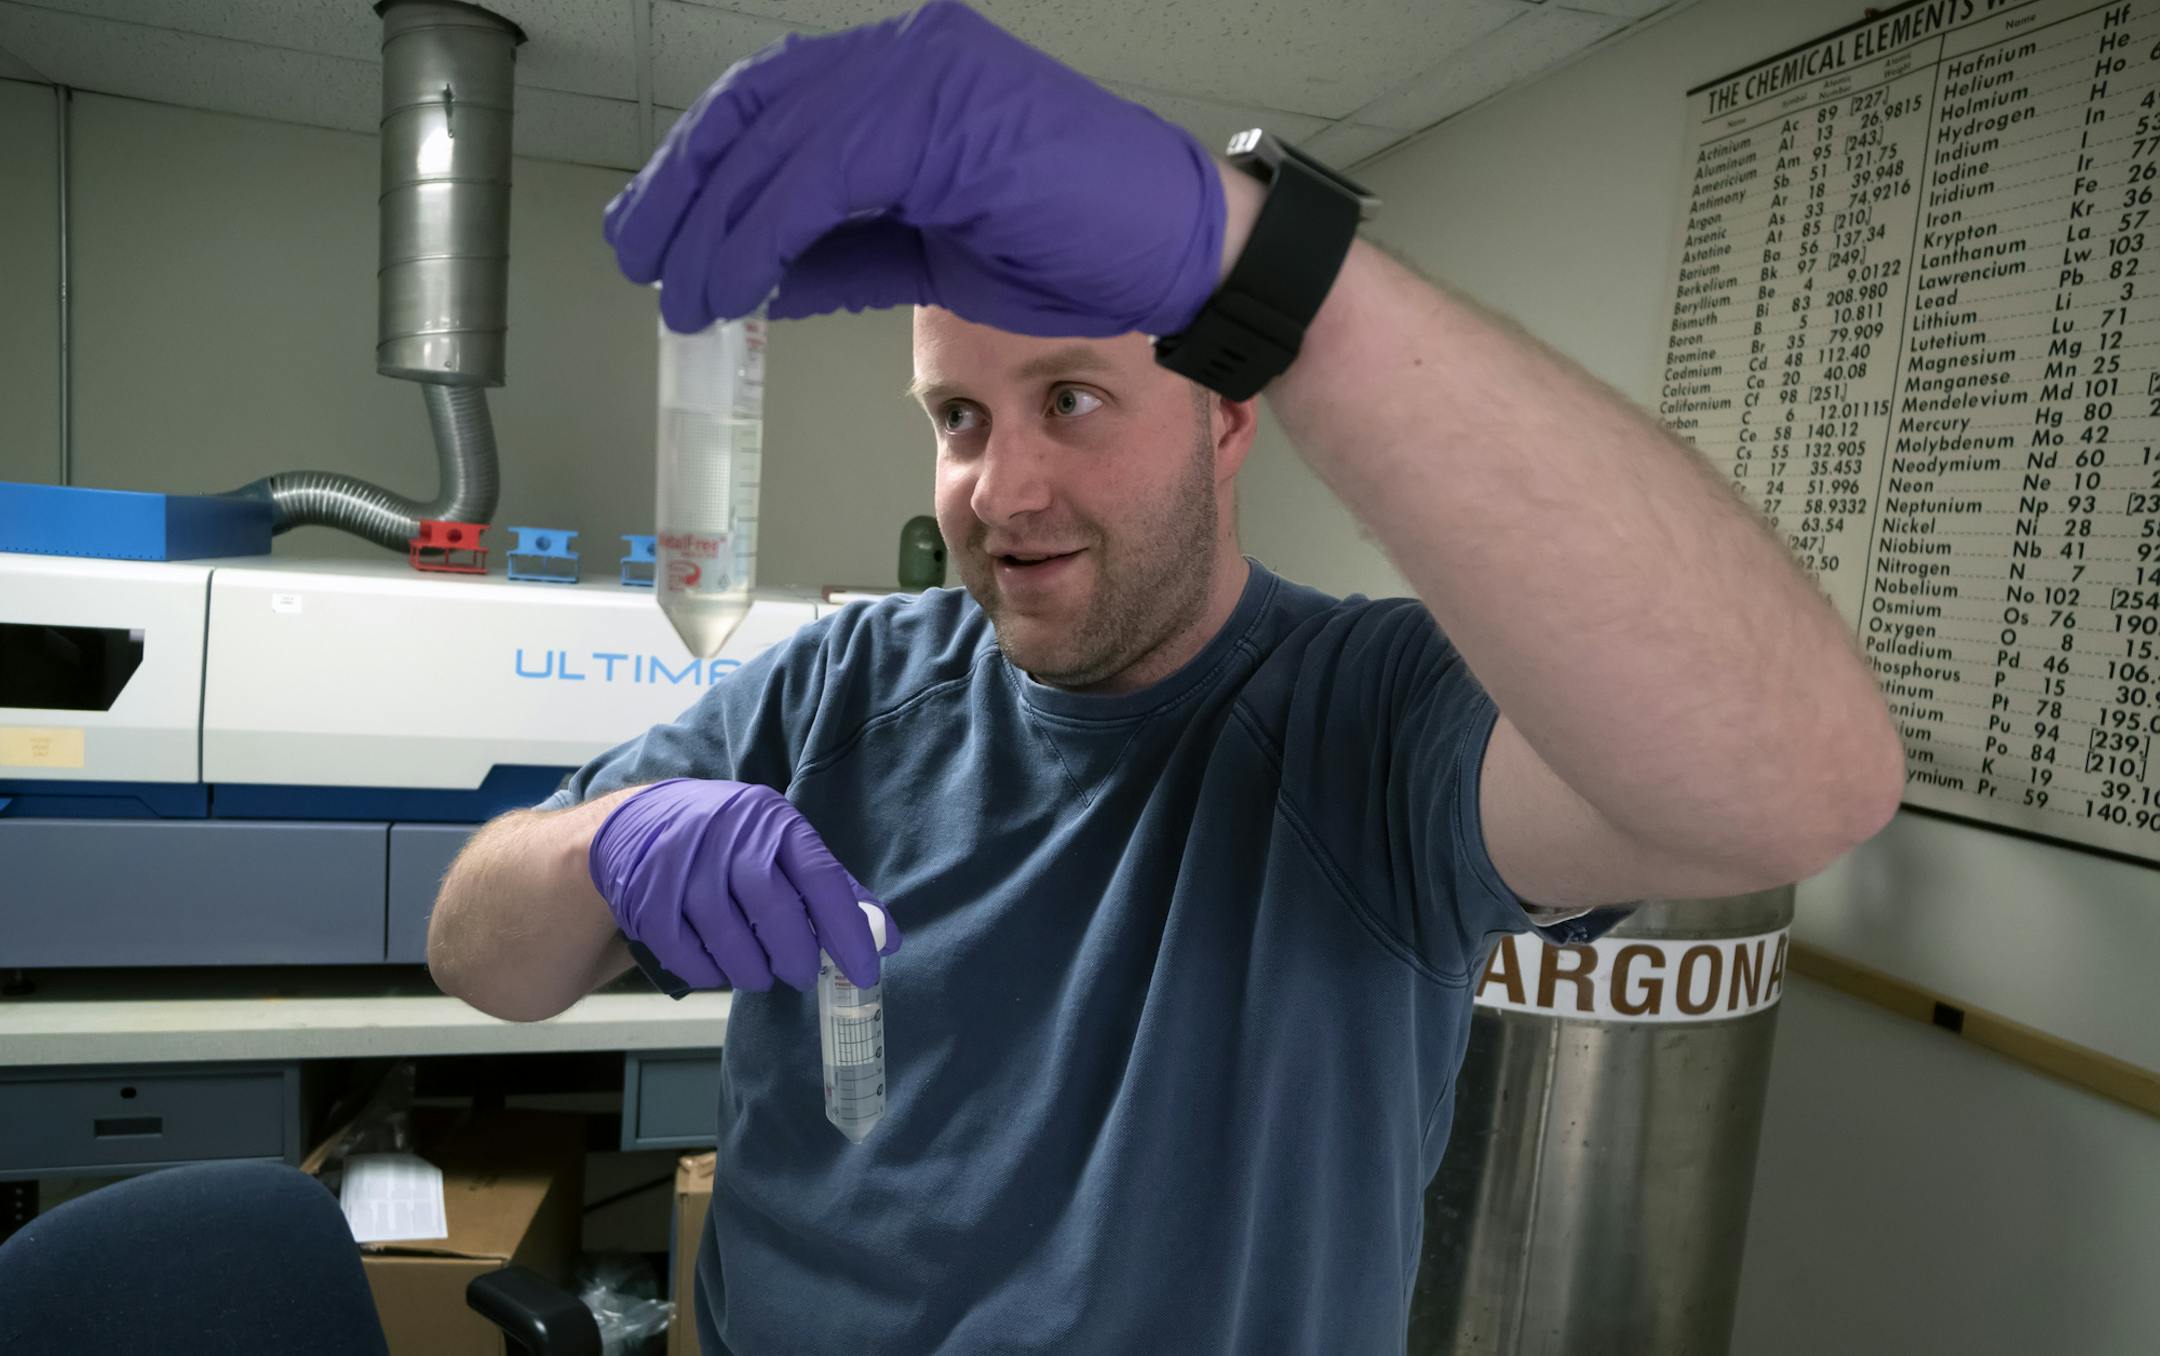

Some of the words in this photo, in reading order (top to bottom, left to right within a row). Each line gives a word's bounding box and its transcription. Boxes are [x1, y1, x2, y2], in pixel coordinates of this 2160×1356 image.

[2006, 14, 2036, 30] Name
[1947, 42, 2036, 80] Hafnium
[2103, 3, 2131, 29] Hf
[1708, 82, 1740, 114] THE
[1745, 40, 1846, 100] CHEMICAL
[1853, 0, 1973, 62] ELEMENTS
[1944, 69, 2014, 101] Helium
[2099, 32, 2130, 54] He
[1941, 86, 2028, 123] Holmium
[2095, 56, 2126, 78] Ho
[1816, 125, 1833, 142] 13
[1860, 94, 1922, 130] 26.9815
[1817, 105, 1838, 123] 89
[1938, 105, 2036, 144] Hydrogen
[1935, 137, 1999, 166] Indium
[2085, 107, 2105, 125] In
[1809, 164, 1827, 180] 51
[1846, 144, 1898, 172] 121.75
[1812, 146, 1832, 162] 95
[1809, 183, 1824, 199] 18
[1852, 161, 1904, 189] 39.948
[1930, 180, 1995, 207] Iridium
[2076, 155, 2094, 172] Ir
[1932, 161, 1990, 186] Iodine
[1804, 202, 1824, 219] 33
[1849, 179, 1910, 208] 74.9216
[1926, 210, 1962, 229] Iron
[2074, 178, 2098, 196] Fe
[2128, 162, 2158, 184] 26
[1802, 221, 1821, 238] 85
[1923, 223, 1998, 250] Krypton
[2070, 201, 2095, 219] Kr
[2123, 186, 2153, 208] 36
[1799, 240, 1818, 256] 56
[1835, 224, 1885, 250] 137.34
[1921, 239, 2026, 270] Lanthanum
[2066, 225, 2091, 242] La
[2118, 210, 2149, 232] 57
[1798, 259, 1818, 274] 97
[1848, 259, 1901, 282] 9.0122
[1918, 260, 2026, 291] Lawrencium
[2063, 248, 2092, 266] Lw
[2109, 233, 2145, 257] 103
[1792, 296, 1811, 313] 83
[1826, 282, 1888, 307] 208.980
[1915, 289, 1958, 310] Lead
[2059, 268, 2084, 288] Pb
[2110, 259, 2139, 280] 82
[1669, 334, 1703, 348] Boron
[1834, 302, 1883, 324] 10.811
[1913, 311, 1977, 332] Lithium
[2055, 292, 2072, 311] Li
[1667, 349, 1716, 365] Bromine
[1751, 340, 1765, 354] Br
[1787, 335, 1805, 350] 35
[1828, 322, 1884, 345] 79.909
[1910, 332, 1986, 352] Lutetium
[2052, 317, 2074, 334] Lu
[2100, 307, 2127, 328] 71
[1664, 364, 1722, 382] Cadmium
[1750, 356, 1768, 372] Cd
[1784, 352, 1803, 367] 48
[1819, 343, 1870, 364] 112.40
[1907, 348, 2016, 373] Magnesium
[2048, 339, 2083, 358] Mg
[2100, 332, 2123, 350] 12
[1662, 382, 1711, 398] Calcium
[1747, 375, 1765, 390] Ca
[1782, 370, 1800, 386] 20
[1824, 362, 1867, 381] 40.08
[1905, 370, 2010, 394] Manganese
[2044, 362, 2077, 380] Mn
[2092, 355, 2120, 375] 25
[1660, 397, 1731, 415] Californium
[1780, 389, 1797, 404] 98
[1820, 399, 1889, 419] 12.01115
[1902, 390, 2028, 414] Mendelevium
[2040, 382, 2073, 402] Md
[2084, 378, 2119, 398] 101
[1740, 428, 1757, 442] Ce
[1774, 426, 1792, 441] 58
[1808, 422, 1859, 439] 140.12
[1899, 417, 1970, 434] Mercury
[2035, 407, 2063, 428] Hg
[2084, 403, 2113, 422] 80
[1771, 445, 1789, 459] 55
[1805, 441, 1866, 457] 132.905
[1895, 435, 2014, 456] Molybdenum
[2032, 430, 2064, 447] Mo
[2080, 426, 2109, 445] 42
[1770, 462, 1785, 476] 17
[1810, 460, 1862, 475] 35.453
[1892, 455, 2001, 476] Neodymium
[2027, 451, 2057, 469] Nd
[2075, 449, 2105, 468] 60
[1766, 480, 1784, 494] 24
[1808, 480, 1859, 494] 51.996
[1889, 477, 1933, 493] Neon
[2023, 473, 2051, 491] Ne
[2074, 472, 2100, 490] 10
[1764, 500, 1781, 513] 27
[1804, 499, 1866, 514] 58.9332
[1885, 497, 1982, 516] Neptunium
[2019, 496, 2049, 517] Np
[2068, 495, 2096, 513] 93
[1802, 518, 1844, 532] 63.54
[1882, 517, 1935, 534] Nickel
[2016, 517, 2038, 536] Ni
[2064, 519, 2092, 537] 28
[1879, 538, 1951, 554] Niobium
[2013, 541, 2042, 558] Nb
[2060, 542, 2086, 560] 41
[1877, 558, 1950, 579] Nitrogen
[1874, 578, 1958, 598] Nobelium
[2007, 586, 2034, 604] No
[2045, 587, 2080, 606] 102
[1869, 617, 1936, 639] Oxygen
[1872, 597, 1942, 618] Osmium
[2004, 607, 2028, 626] Os
[2049, 610, 2076, 629] 76
[1866, 636, 1952, 660] Palladium
[1997, 651, 2020, 669] Pd
[2043, 656, 2069, 674] 46
[2044, 678, 2066, 697] 15
[1992, 693, 2009, 711] Pt
[2036, 700, 2062, 719] 78
[1989, 714, 2010, 733] Pu
[2034, 722, 2059, 742] 94
[1985, 736, 2008, 756] Po
[2030, 744, 2055, 764] 84
[2030, 767, 2052, 786] 19
[1978, 779, 1997, 798] Pr
[2022, 789, 2048, 808] 59
